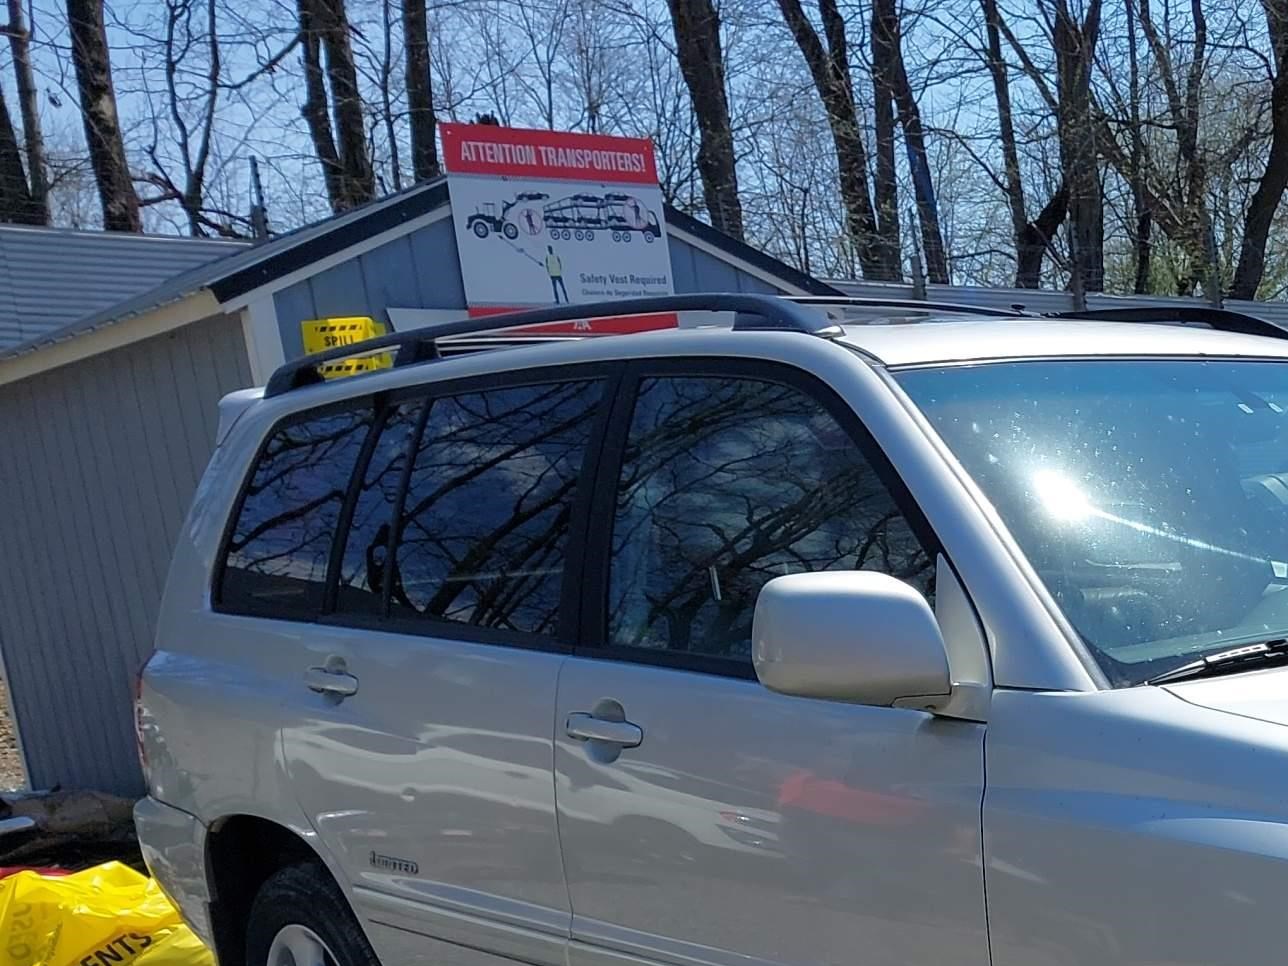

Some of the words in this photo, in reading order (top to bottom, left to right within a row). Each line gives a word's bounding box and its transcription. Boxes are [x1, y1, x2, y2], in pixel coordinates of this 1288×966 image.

[461, 141, 536, 165] ATTENTION
[540, 146, 646, 172] TRANSPORTERS!
[580, 273, 607, 286] Safety
[609, 273, 628, 285] Vest
[630, 274, 667, 286] Required
